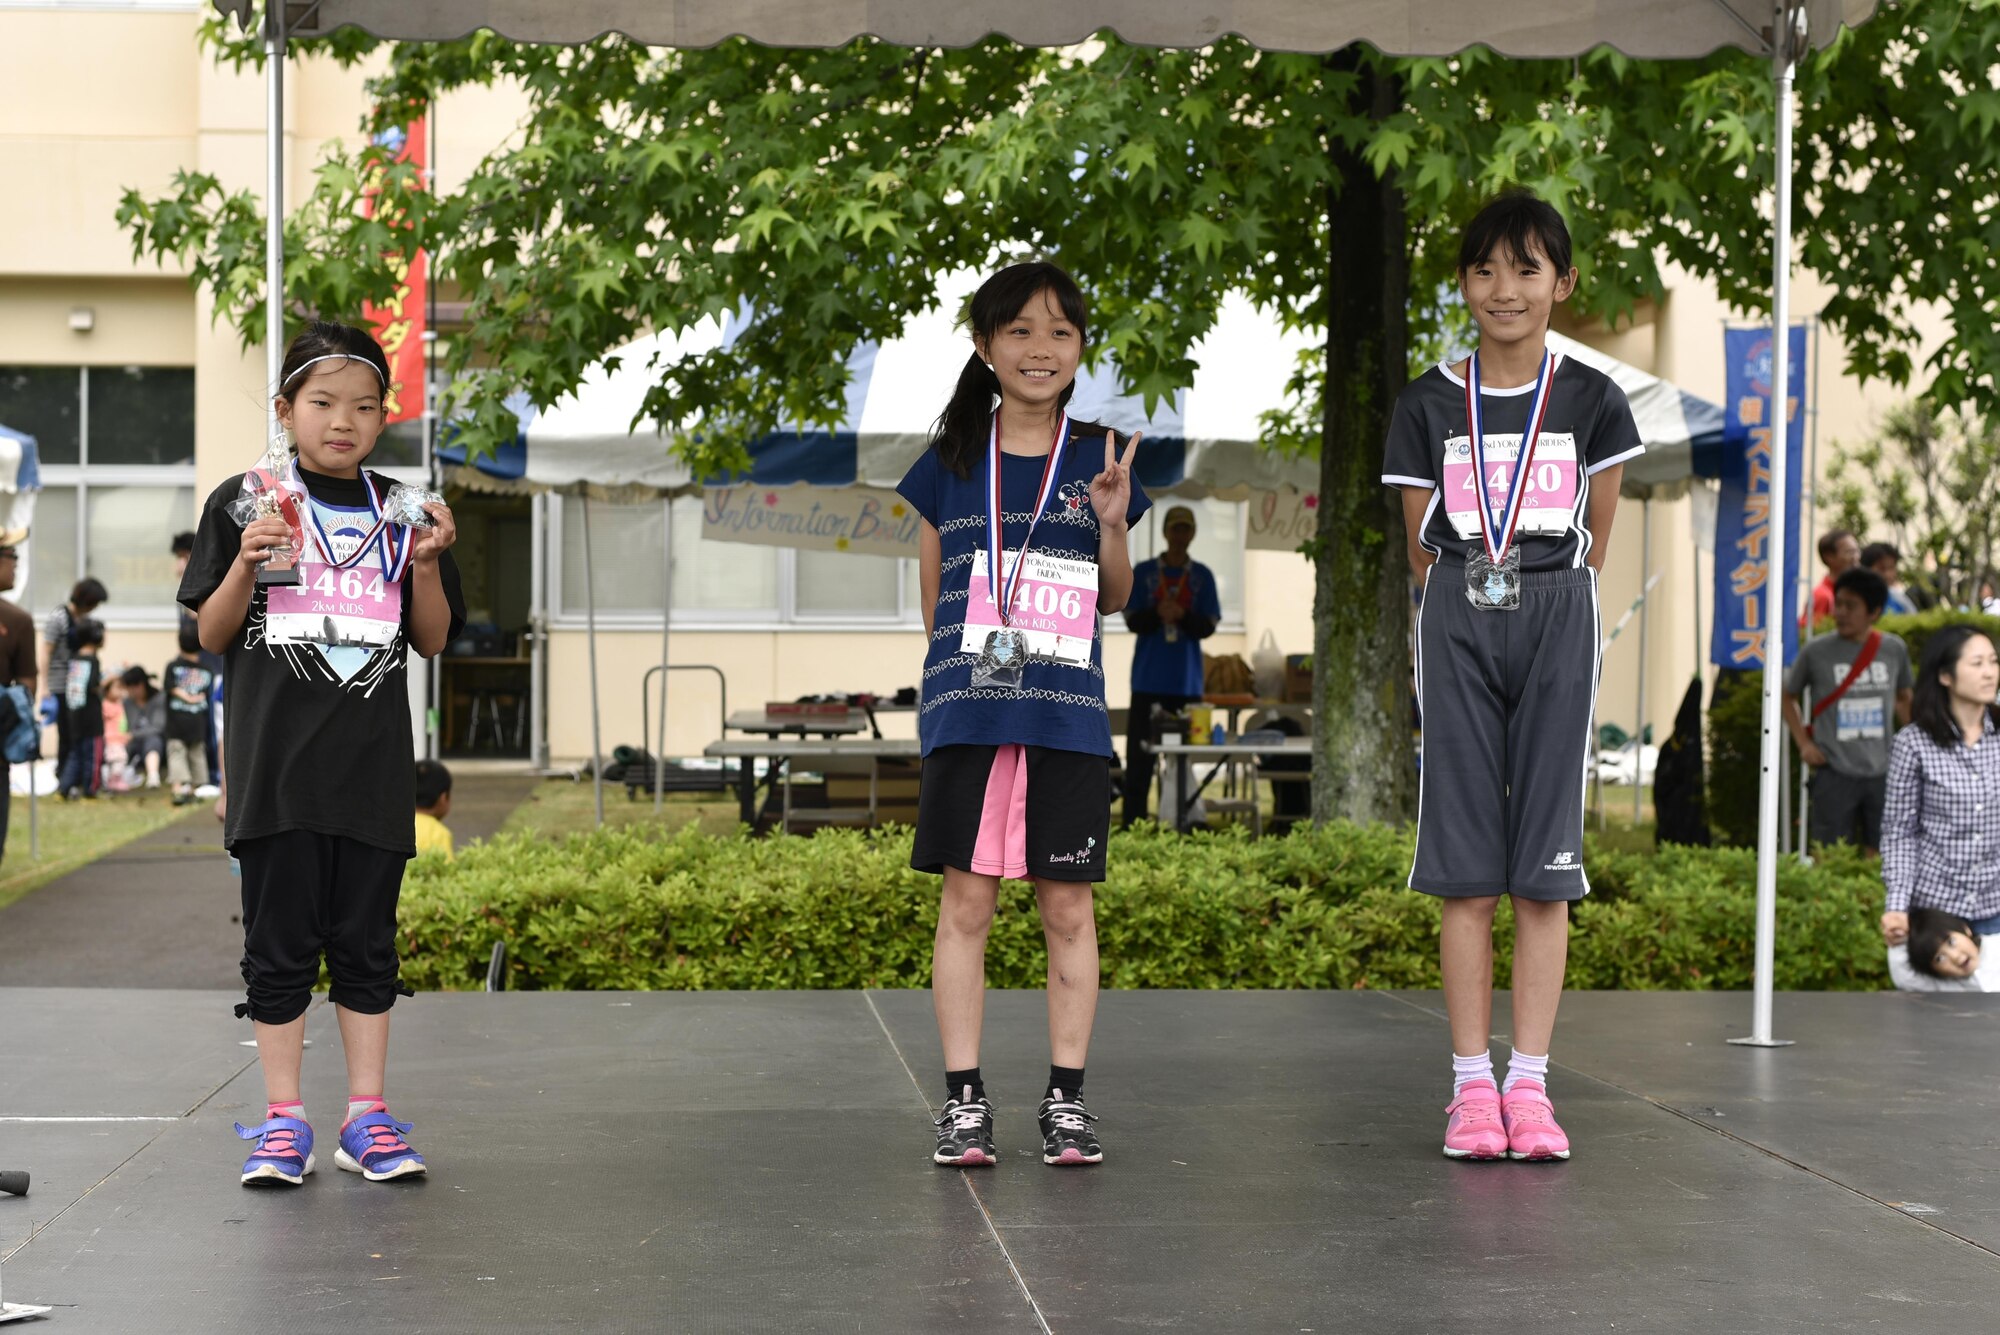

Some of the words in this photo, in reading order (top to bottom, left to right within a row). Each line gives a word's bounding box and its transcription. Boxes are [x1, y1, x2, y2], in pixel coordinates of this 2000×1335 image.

[1537, 439, 1567, 447] TRIDERS
[1520, 496, 1539, 507] IDS
[704, 489, 849, 539] Information
[1026, 558, 1058, 570] YOKOTA
[1059, 563, 1090, 576] STRIDERS
[1036, 568, 1062, 580] EKIDEN
[286, 565, 387, 602] 4464
[339, 602, 364, 615] KIDS
[1032, 618, 1057, 631] KIDS
[1049, 853, 1075, 863] Lovely
